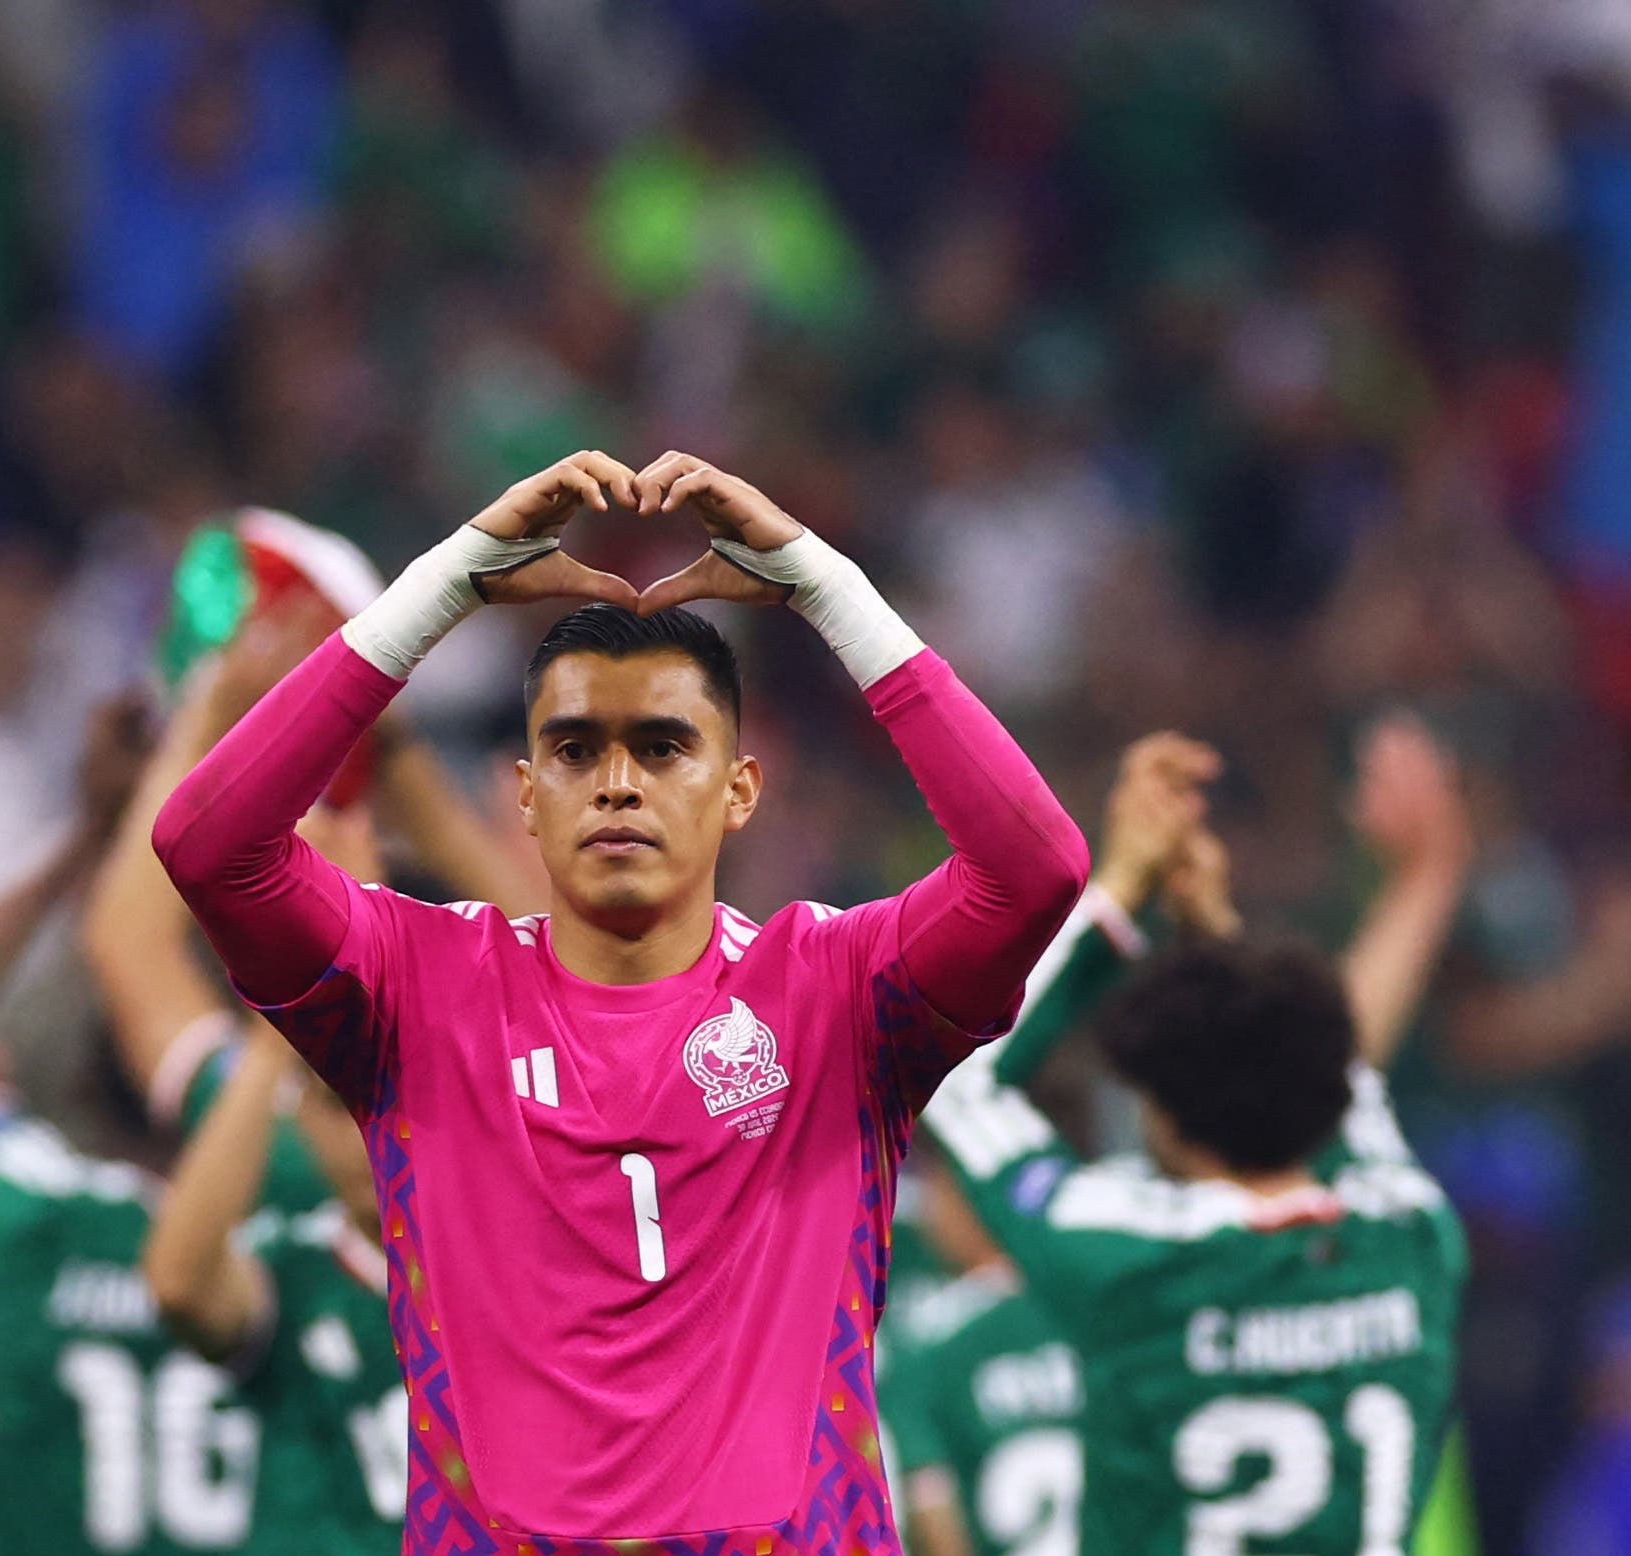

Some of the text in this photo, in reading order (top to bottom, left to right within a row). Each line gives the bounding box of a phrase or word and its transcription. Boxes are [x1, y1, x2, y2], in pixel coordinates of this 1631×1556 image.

[709, 1072, 783, 1112] MÉXICO
[620, 1152, 666, 1282] 1
[57, 1340, 261, 1553] 16
